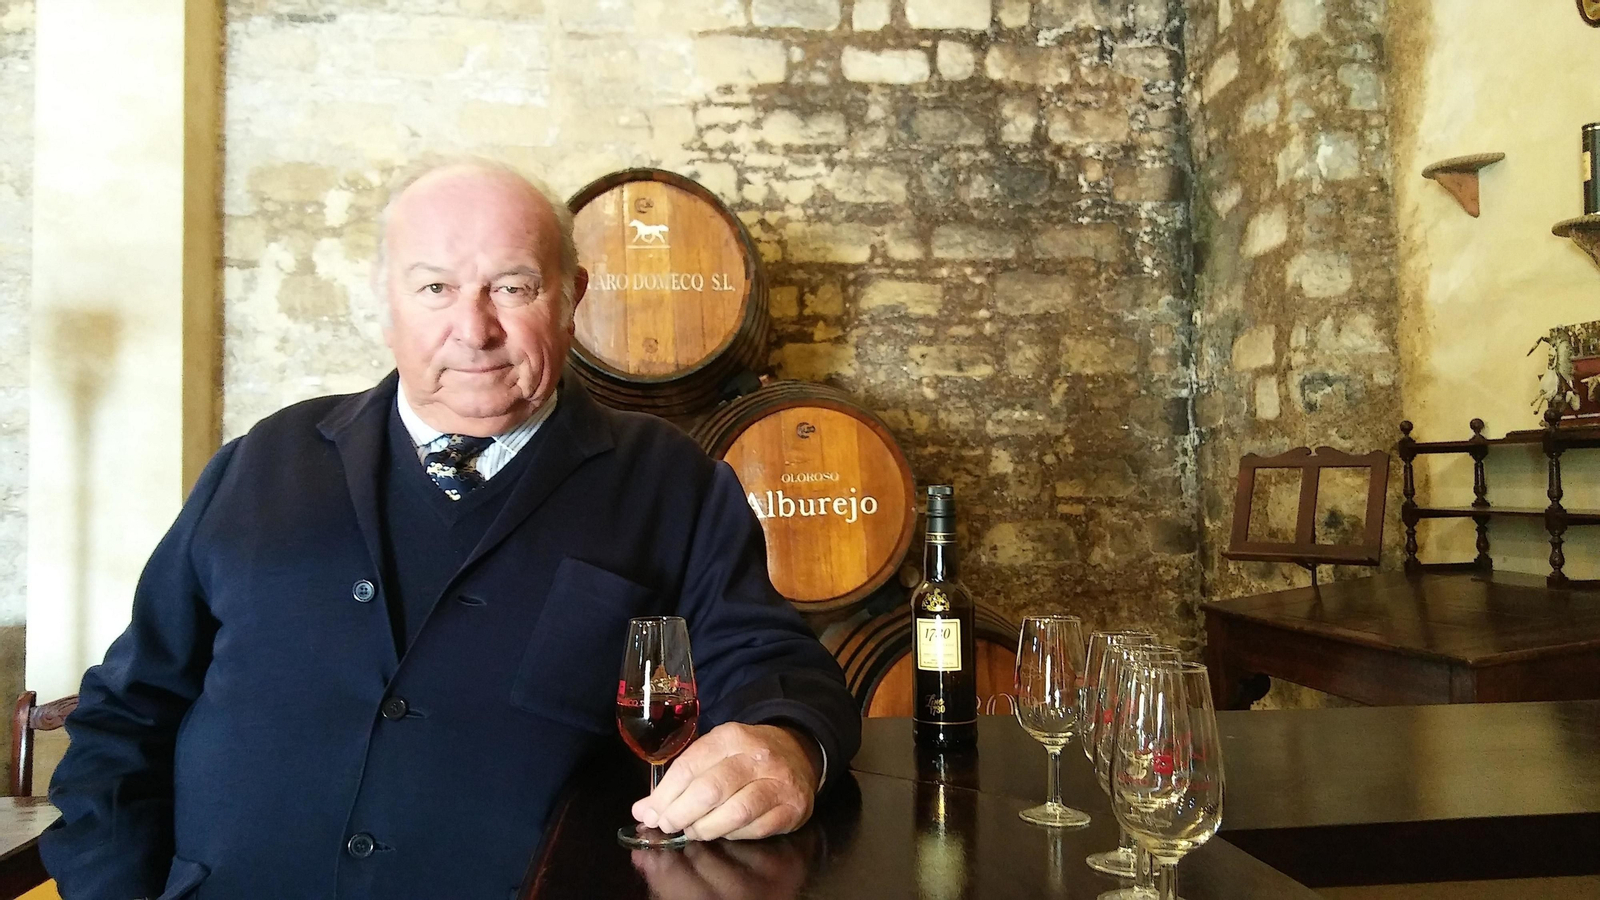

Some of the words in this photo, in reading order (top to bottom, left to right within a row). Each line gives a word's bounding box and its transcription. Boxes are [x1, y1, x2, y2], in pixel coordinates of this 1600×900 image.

[633, 273, 704, 292] DOMECQ
[781, 471, 840, 483] OLOROSO
[747, 487, 878, 524] Alburejo
